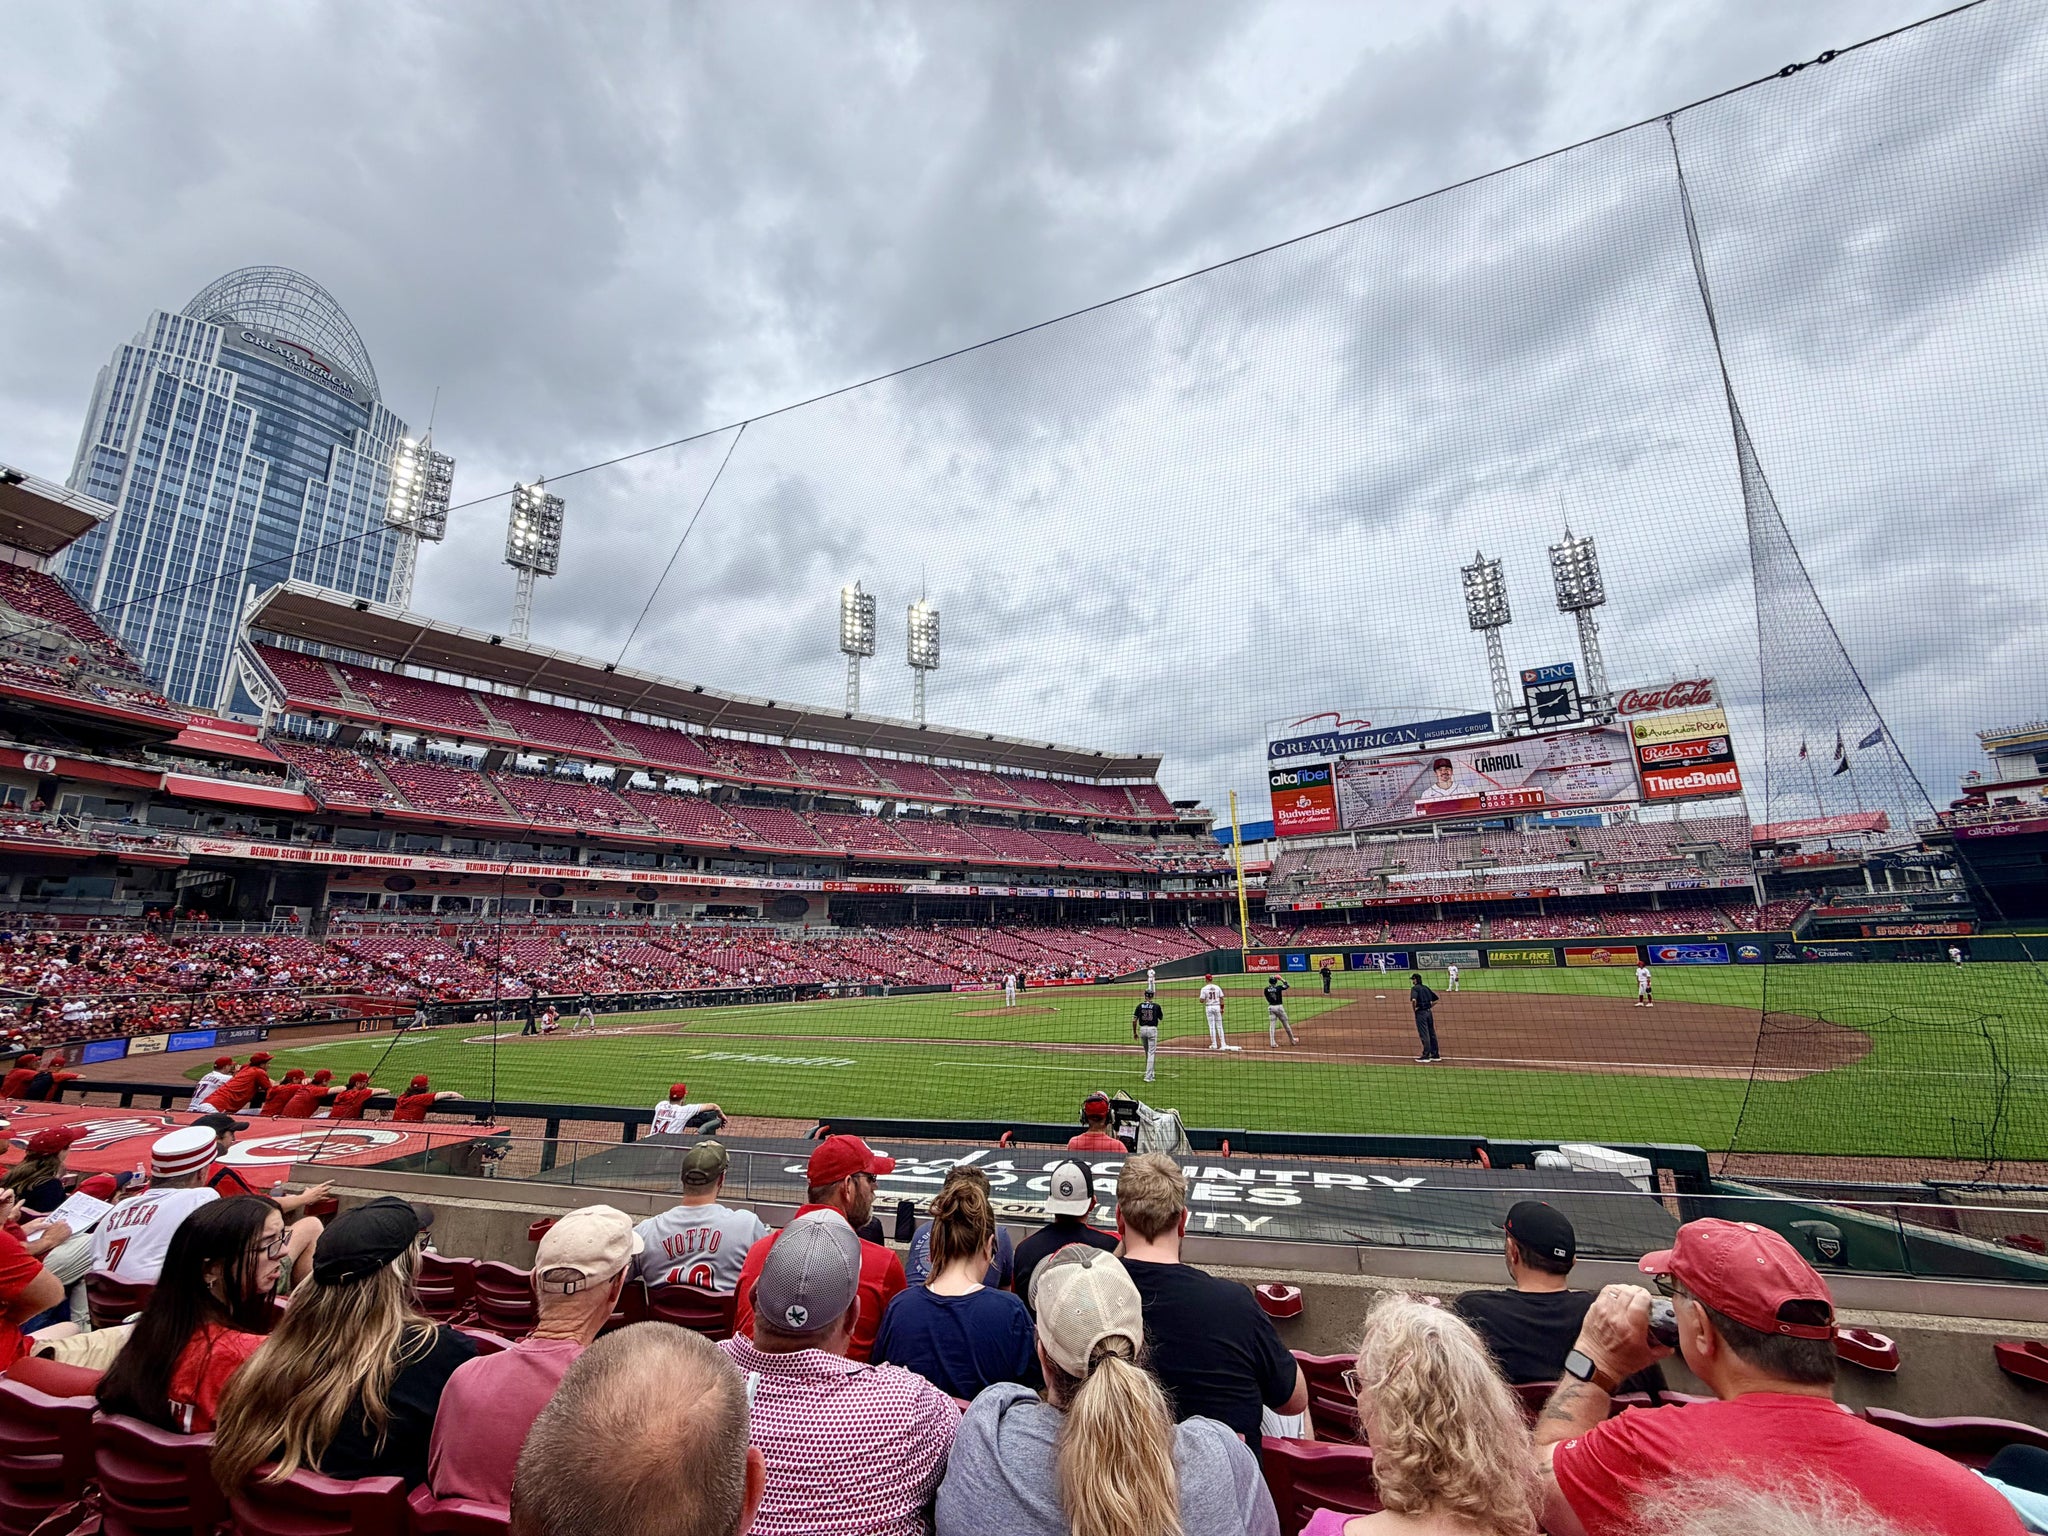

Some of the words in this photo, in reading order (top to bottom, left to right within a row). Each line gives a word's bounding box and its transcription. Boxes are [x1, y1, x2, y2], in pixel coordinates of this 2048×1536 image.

[1538, 664, 1573, 680] PNC
[1617, 677, 1714, 715] Coca-Cola
[1424, 727, 1463, 739] INSURANCE
[1464, 723, 1489, 733] GROUP
[1649, 725, 1697, 737] Avocados
[1696, 721, 1726, 732] Peru
[30, 754, 49, 771] 14
[1474, 753, 1524, 773] CARROLL
[1271, 769, 1329, 787] altafiber
[1645, 769, 1738, 792] ThreeBond
[1278, 807, 1331, 820] Budweiser
[1562, 807, 1594, 816] TOYOTA
[1595, 804, 1631, 813] TUNDRA
[1968, 823, 2020, 836] altafiber
[250, 846, 279, 858] BEHIND
[281, 848, 312, 861] SECTION
[331, 852, 347, 863] AND
[350, 853, 366, 865] FORT
[368, 854, 400, 867] MITCHELL
[402, 857, 413, 867] KY
[1901, 854, 1941, 864] XAVIER
[465, 861, 487, 872] BEHIND
[541, 866, 555, 876] FORT
[556, 867, 581, 877] MITCHELL
[581, 869, 590, 878] KY
[631, 872, 648, 881] BEHIND
[650, 873, 668, 882] SECTION
[1720, 877, 1745, 887] ROSE
[1490, 952, 1520, 961] WEST
[1522, 951, 1550, 960] LAKE
[1660, 947, 1719, 960] Crest
[1208, 991, 1216, 1000] 31
[230, 1029, 256, 1038] XAVIER
[1042, 1160, 1427, 1193] CONTRY
[106, 1204, 159, 1233] STEER
[662, 1228, 722, 1260] VOTTO
[105, 1236, 131, 1272] 7
